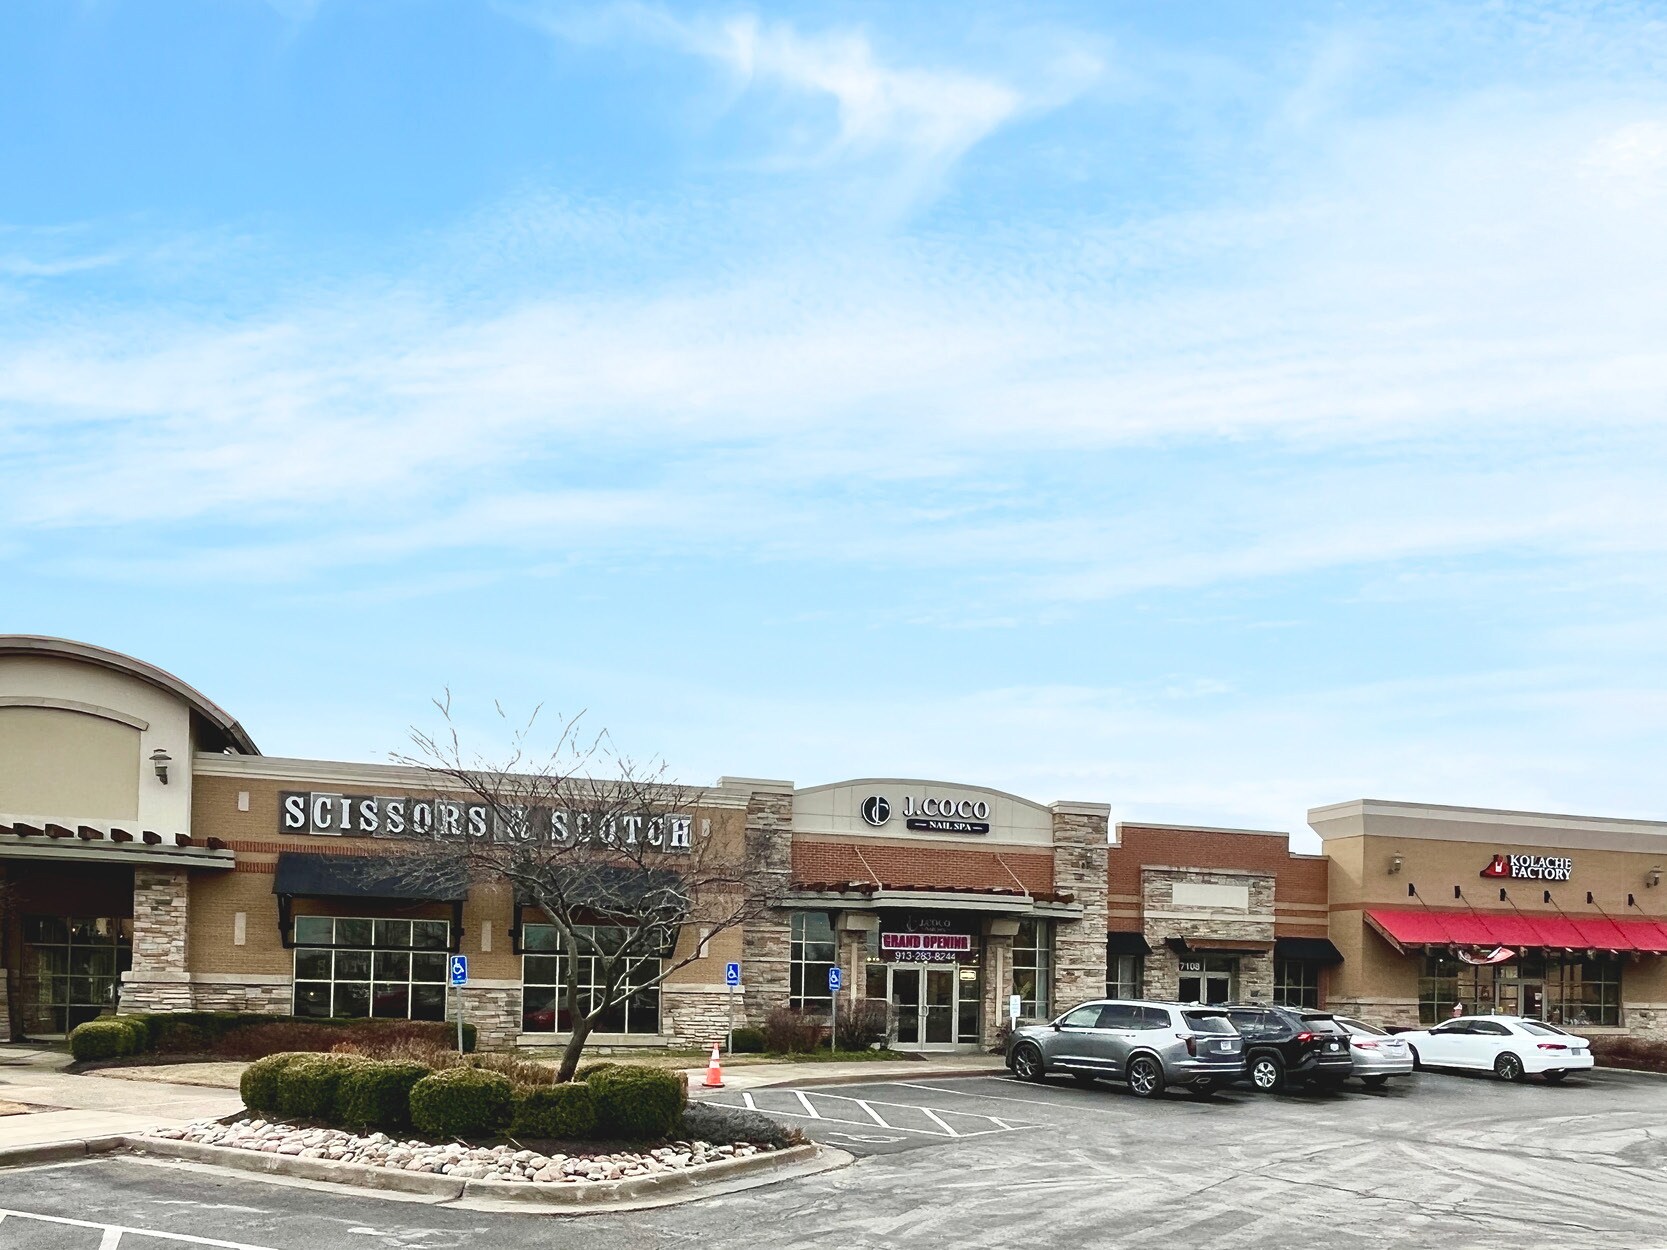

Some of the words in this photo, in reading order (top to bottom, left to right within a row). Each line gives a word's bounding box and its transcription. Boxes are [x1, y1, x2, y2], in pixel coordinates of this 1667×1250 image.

[902, 796, 990, 820] J.COCO
[285, 796, 487, 837] SCISSORS
[551, 811, 692, 847] SCOTCH
[929, 821, 953, 831] NAIL
[954, 823, 972, 831] SPA
[1510, 854, 1572, 870] KOLACHE
[1511, 866, 1572, 880] FACTORY
[883, 934, 921, 949] GRAND
[923, 935, 968, 950] OPENING
[895, 951, 956, 961] 913-283-8244
